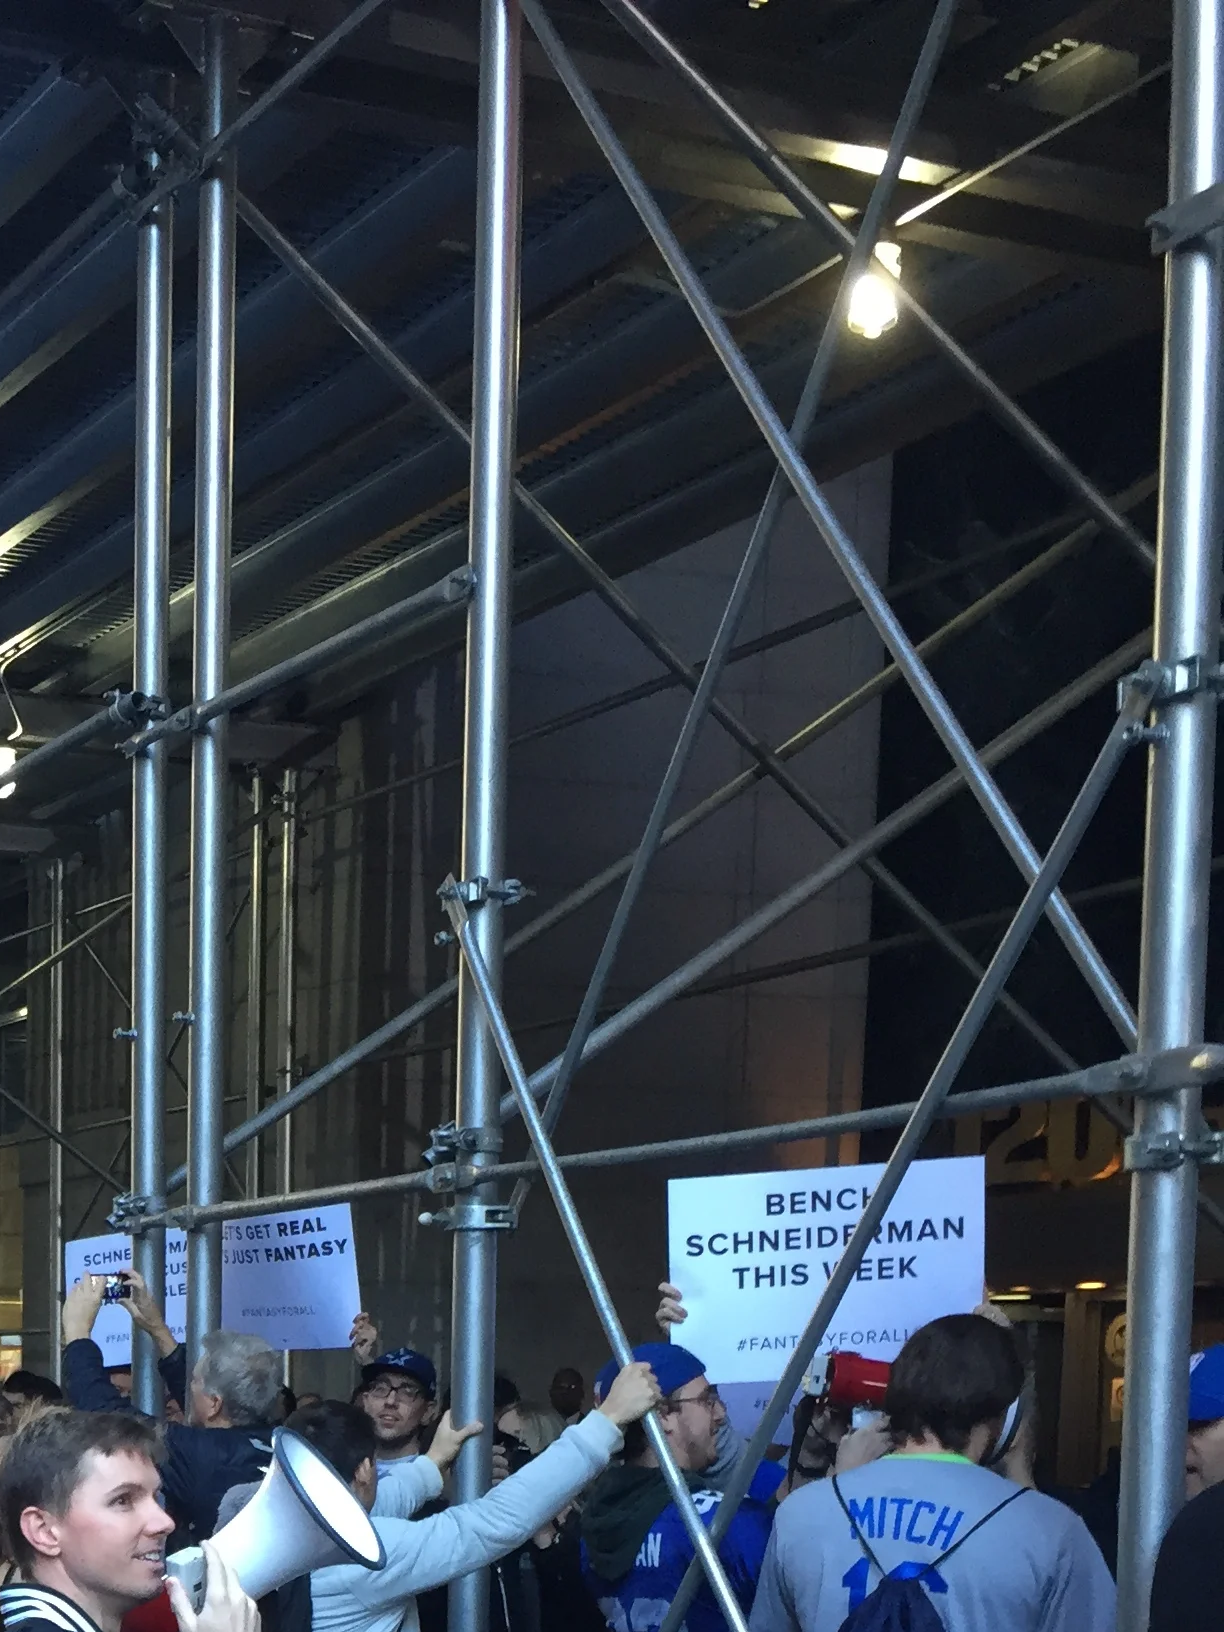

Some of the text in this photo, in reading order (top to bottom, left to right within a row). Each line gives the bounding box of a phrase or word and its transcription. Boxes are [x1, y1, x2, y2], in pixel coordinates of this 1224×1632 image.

[245, 1223, 270, 1241] GET
[277, 1217, 327, 1237] REAL
[231, 1249, 260, 1265] JUST
[264, 1239, 348, 1263] FANTASY
[733, 1264, 809, 1290] THIS
[737, 1328, 908, 1351] #FANTYFORAL
[849, 1496, 964, 1551] MITCH
